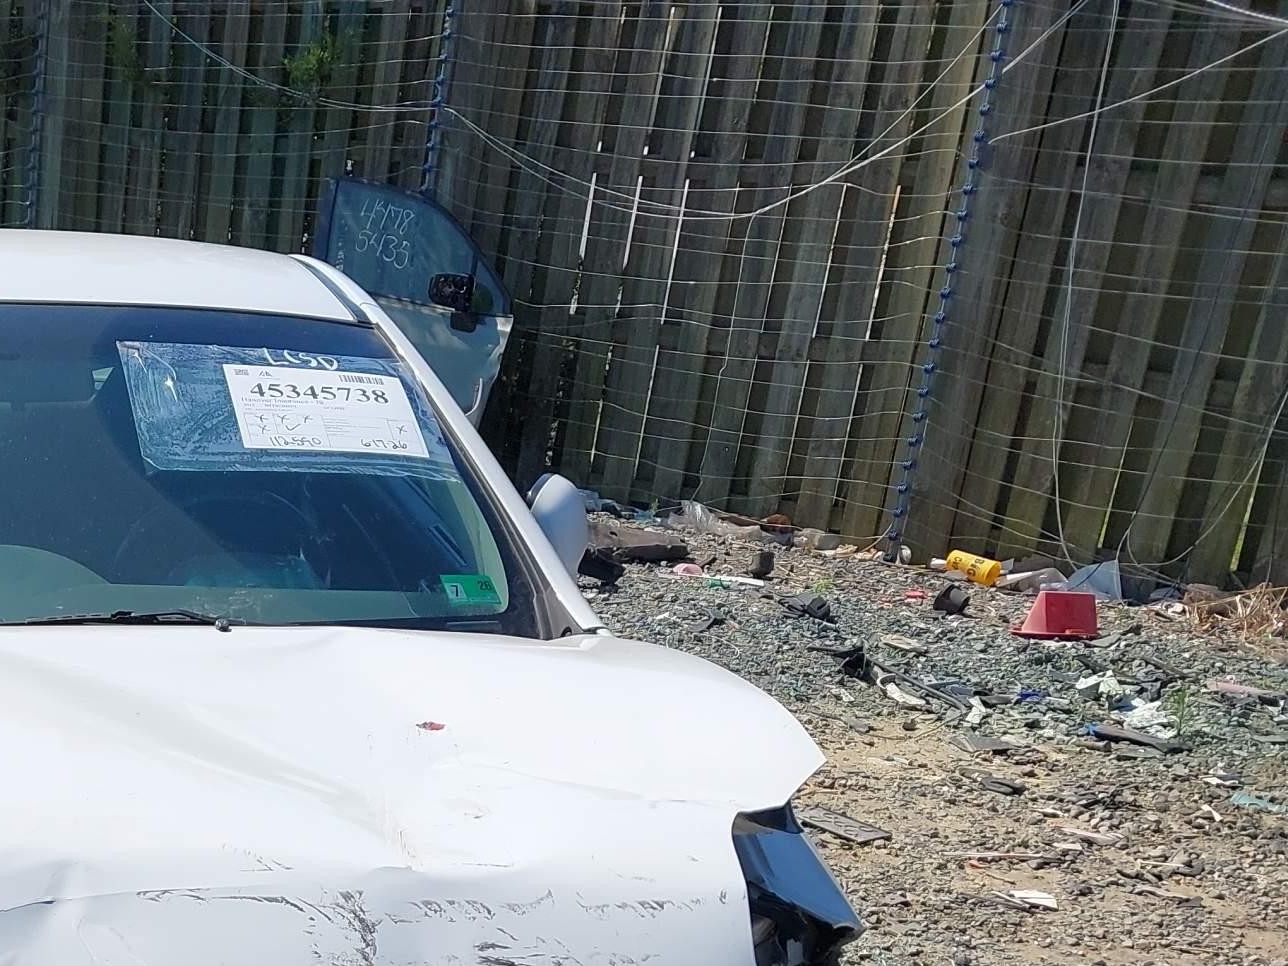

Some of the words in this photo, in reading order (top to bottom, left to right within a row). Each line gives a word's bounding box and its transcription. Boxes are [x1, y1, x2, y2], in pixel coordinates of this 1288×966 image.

[355, 230, 410, 269] 5435
[249, 382, 390, 405] 45345738
[450, 584, 460, 598] 7
